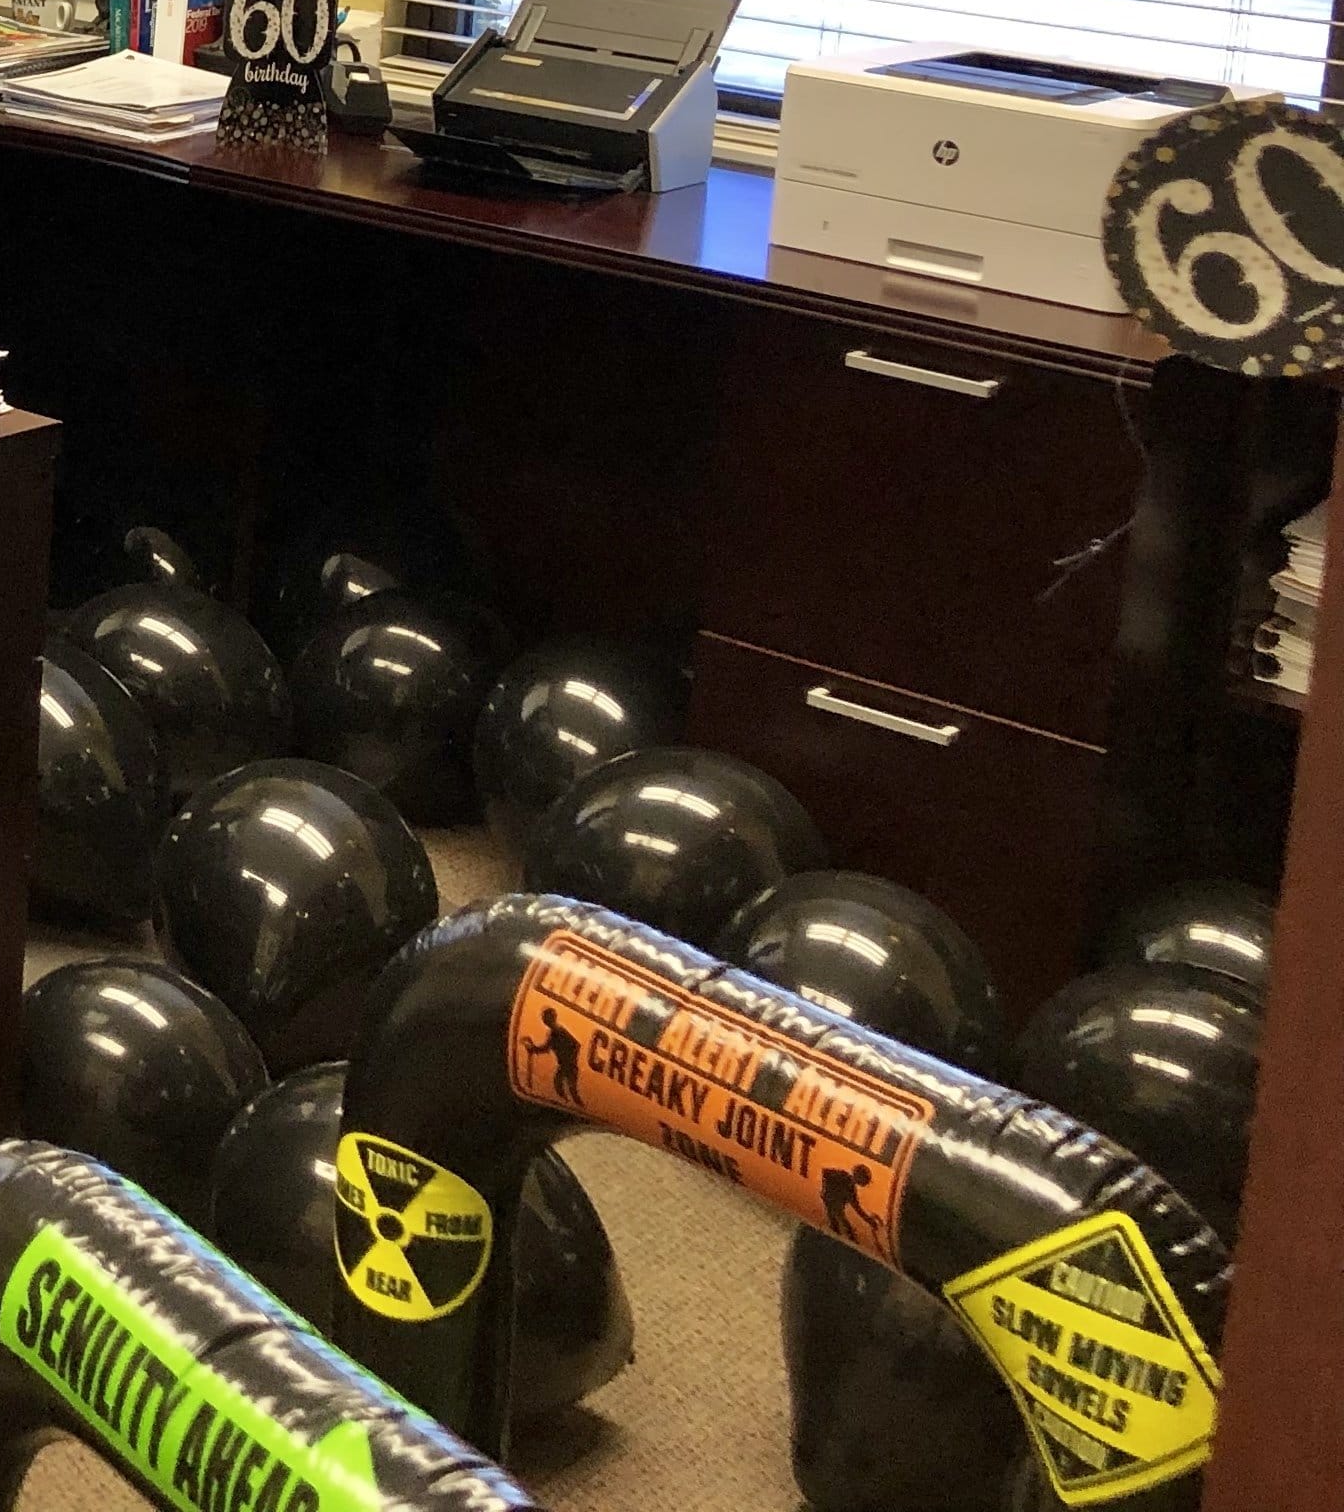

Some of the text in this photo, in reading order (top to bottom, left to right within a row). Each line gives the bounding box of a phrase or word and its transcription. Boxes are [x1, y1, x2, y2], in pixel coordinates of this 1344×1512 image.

[185, 18, 209, 34] 2019
[244, 61, 310, 94] birthday
[1134, 128, 1344, 339] 60
[541, 949, 894, 1156] ALERT ALERT ALERT
[587, 1030, 817, 1179] CREAKY JOINT
[366, 1147, 419, 1188] TOXIC
[660, 1121, 744, 1184] ZONE
[425, 1210, 483, 1236] FROM
[17, 1258, 191, 1470] SENILITY
[991, 1294, 1188, 1408] SLOW MOVING
